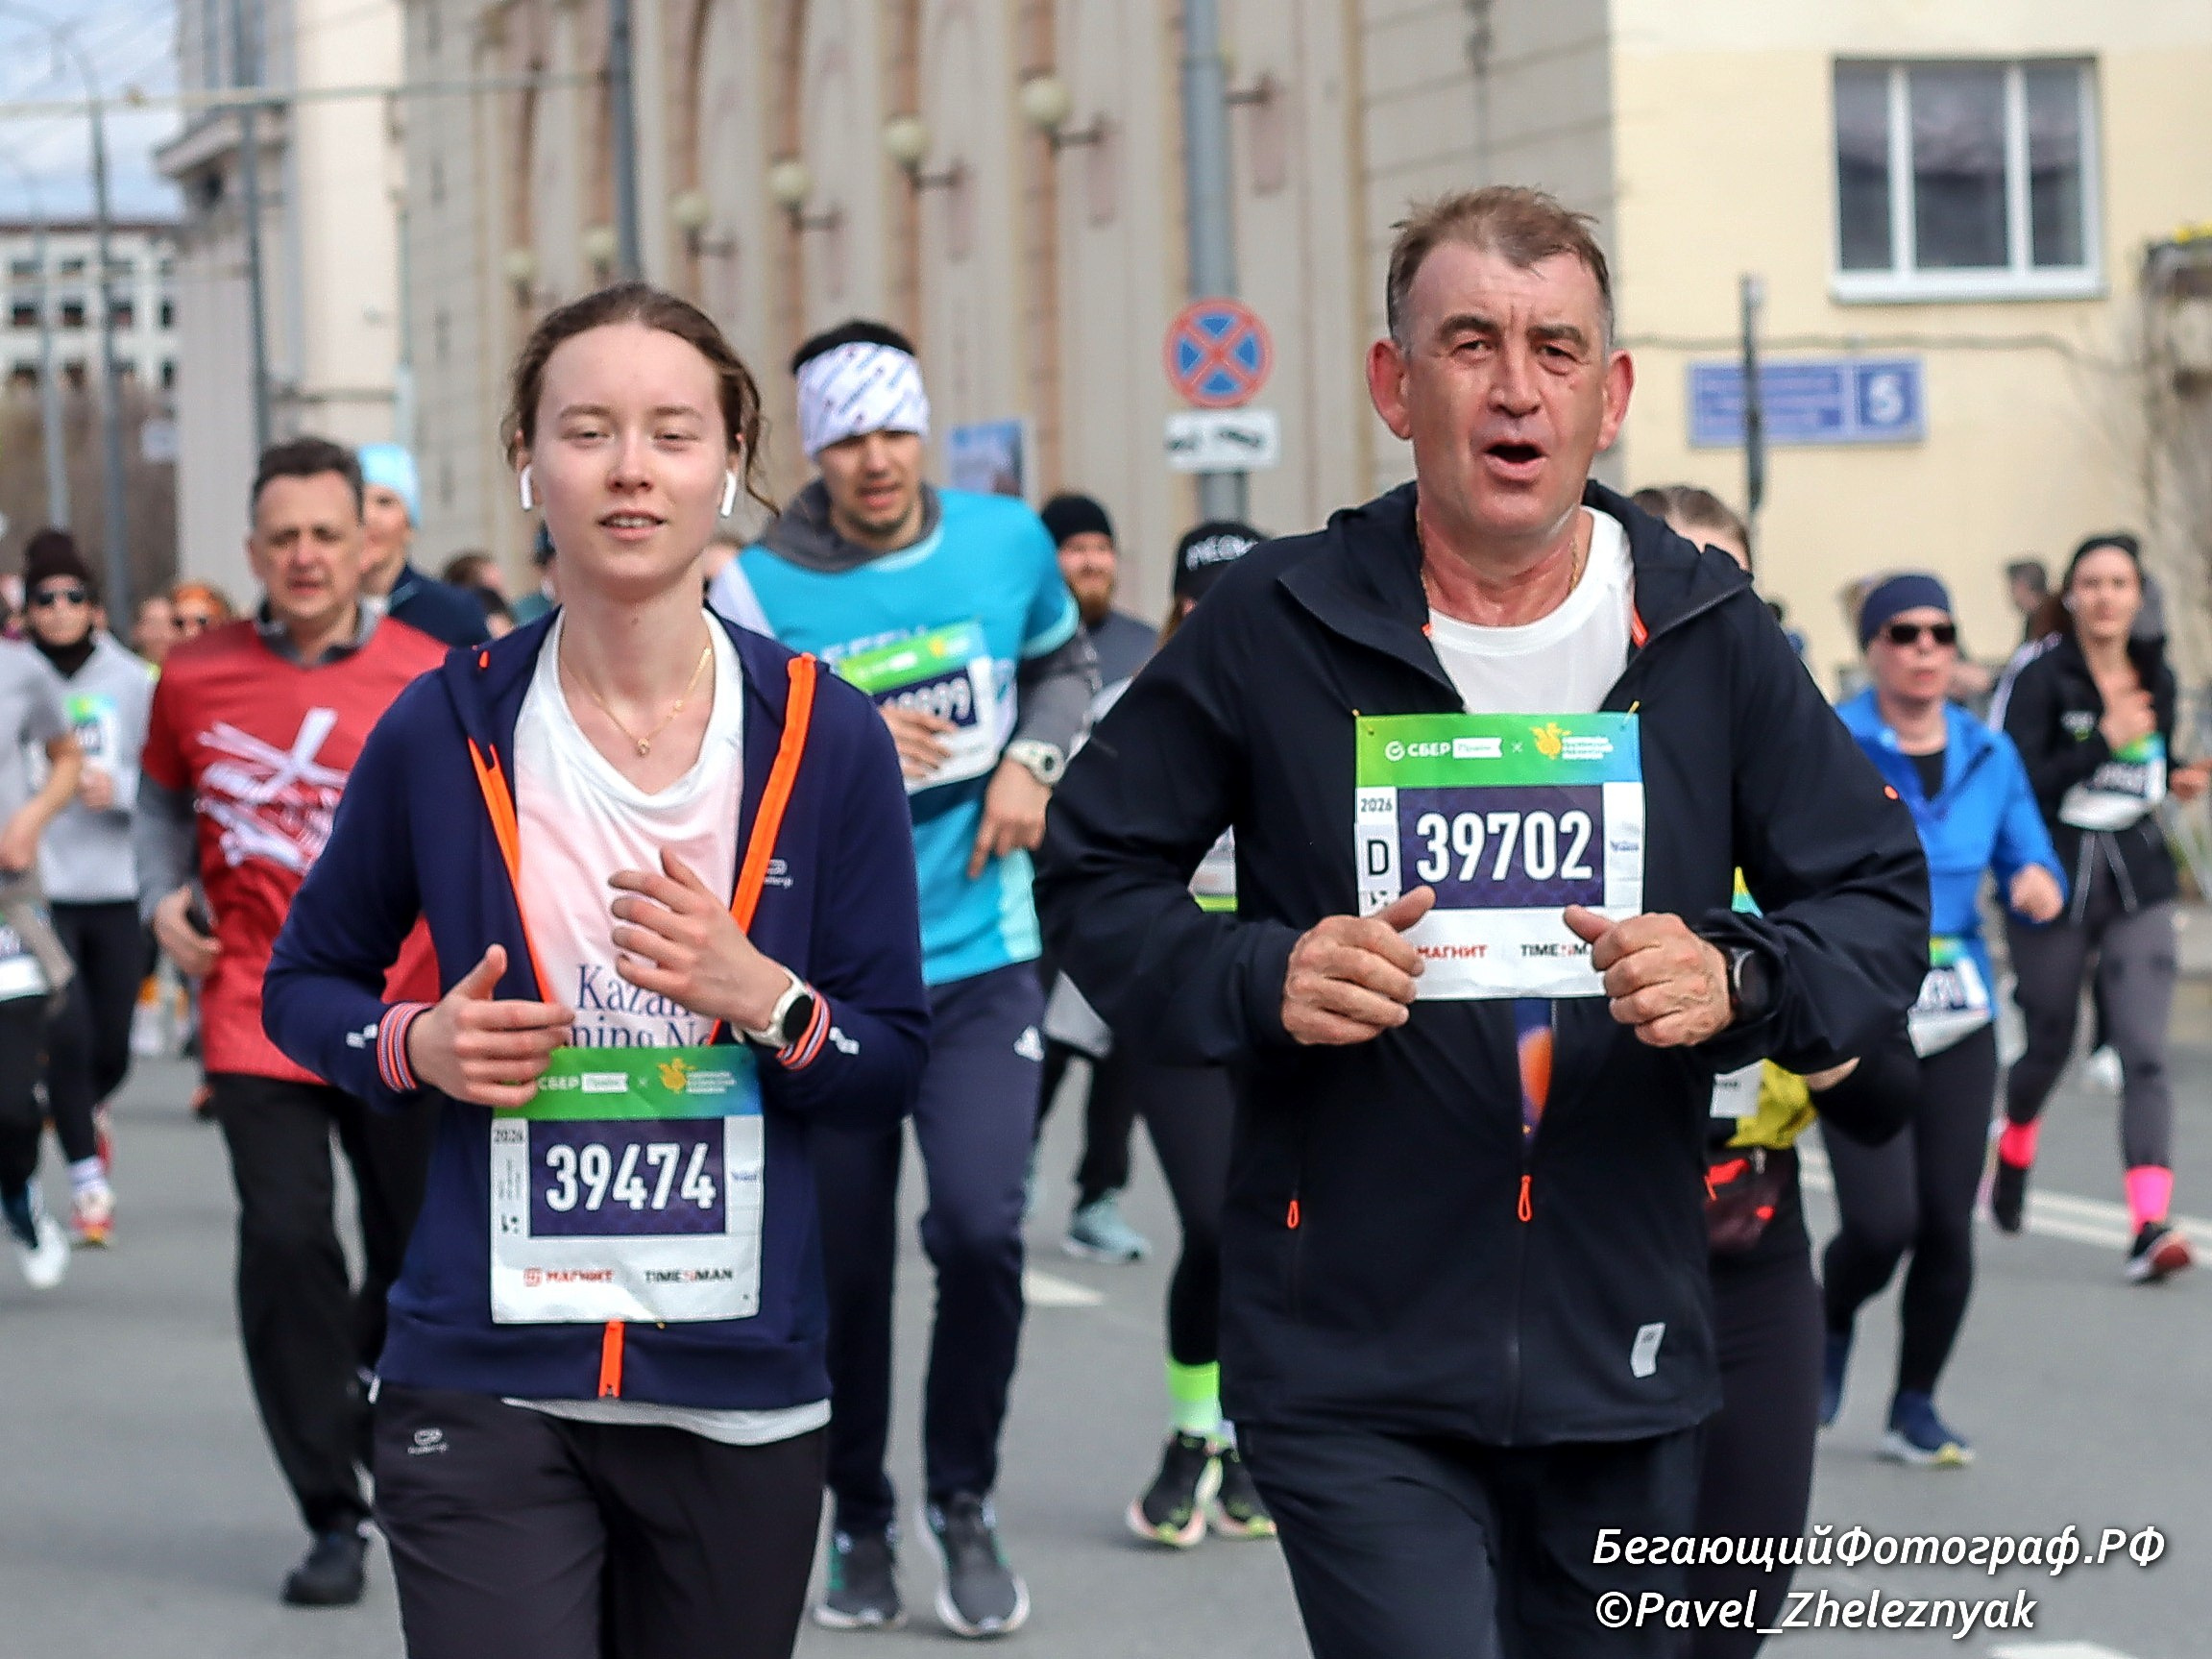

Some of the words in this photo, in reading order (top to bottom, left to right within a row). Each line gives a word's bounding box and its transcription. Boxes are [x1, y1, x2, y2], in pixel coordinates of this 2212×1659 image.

[1360, 797, 1393, 813] 2026
[1368, 840, 1389, 875] D
[1416, 810, 1593, 883] 39702
[1418, 943, 1488, 959] МАГНИТ
[546, 1142, 717, 1211] 39474
